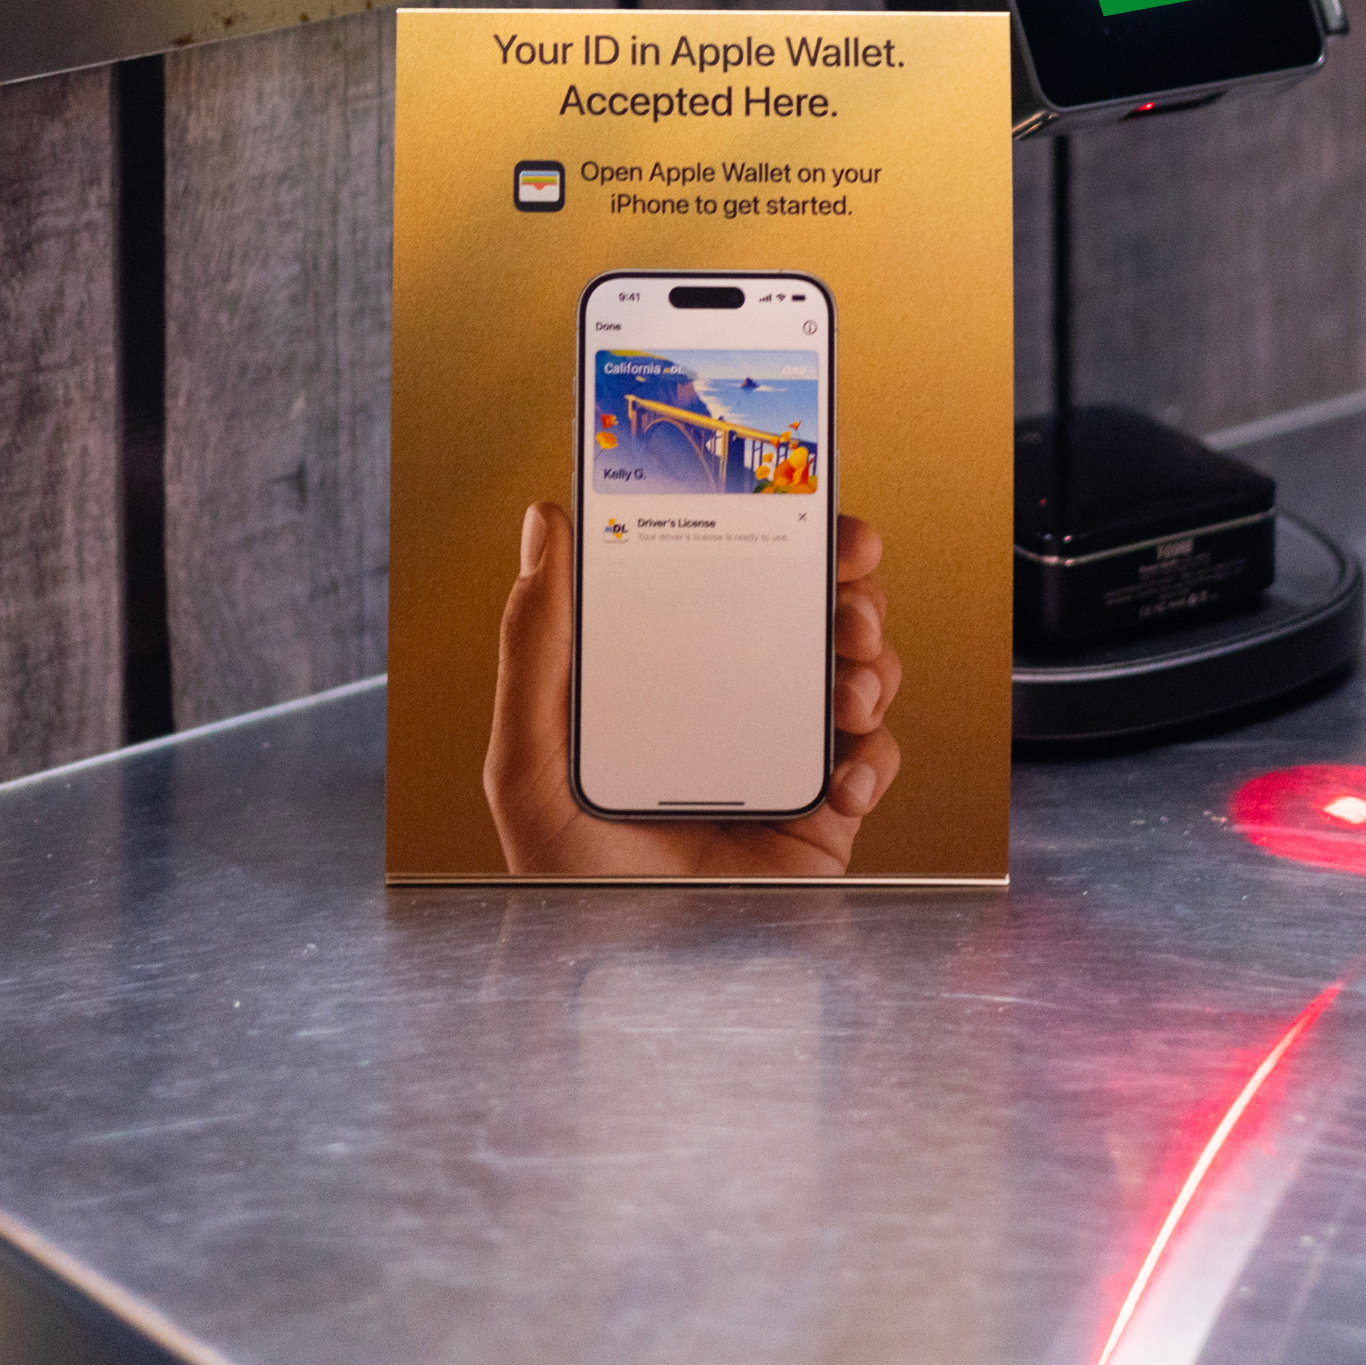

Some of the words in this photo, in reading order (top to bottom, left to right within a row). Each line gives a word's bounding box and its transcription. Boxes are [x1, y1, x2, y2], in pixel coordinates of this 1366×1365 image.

[493, 33, 574, 65] Your
[584, 34, 620, 65] ID
[631, 35, 660, 66] in
[670, 35, 775, 73] Apple
[785, 36, 905, 68] Wallet.
[559, 84, 732, 123] Accepted
[745, 86, 838, 118] Here.
[581, 161, 643, 186] Open
[649, 161, 716, 187] Apple
[722, 162, 791, 183] Wallet
[797, 167, 825, 183] on
[832, 167, 882, 188] your
[611, 193, 689, 214] iPhone
[695, 195, 718, 214] to
[723, 196, 760, 219] get
[766, 195, 853, 216] started.
[618, 292, 641, 303] 9:41
[595, 321, 622, 332] Done
[604, 362, 661, 375] California
[604, 468, 631, 482] Kelly
[634, 468, 647, 481] G.
[637, 517, 676, 529] Driver's
[678, 518, 716, 529] License
